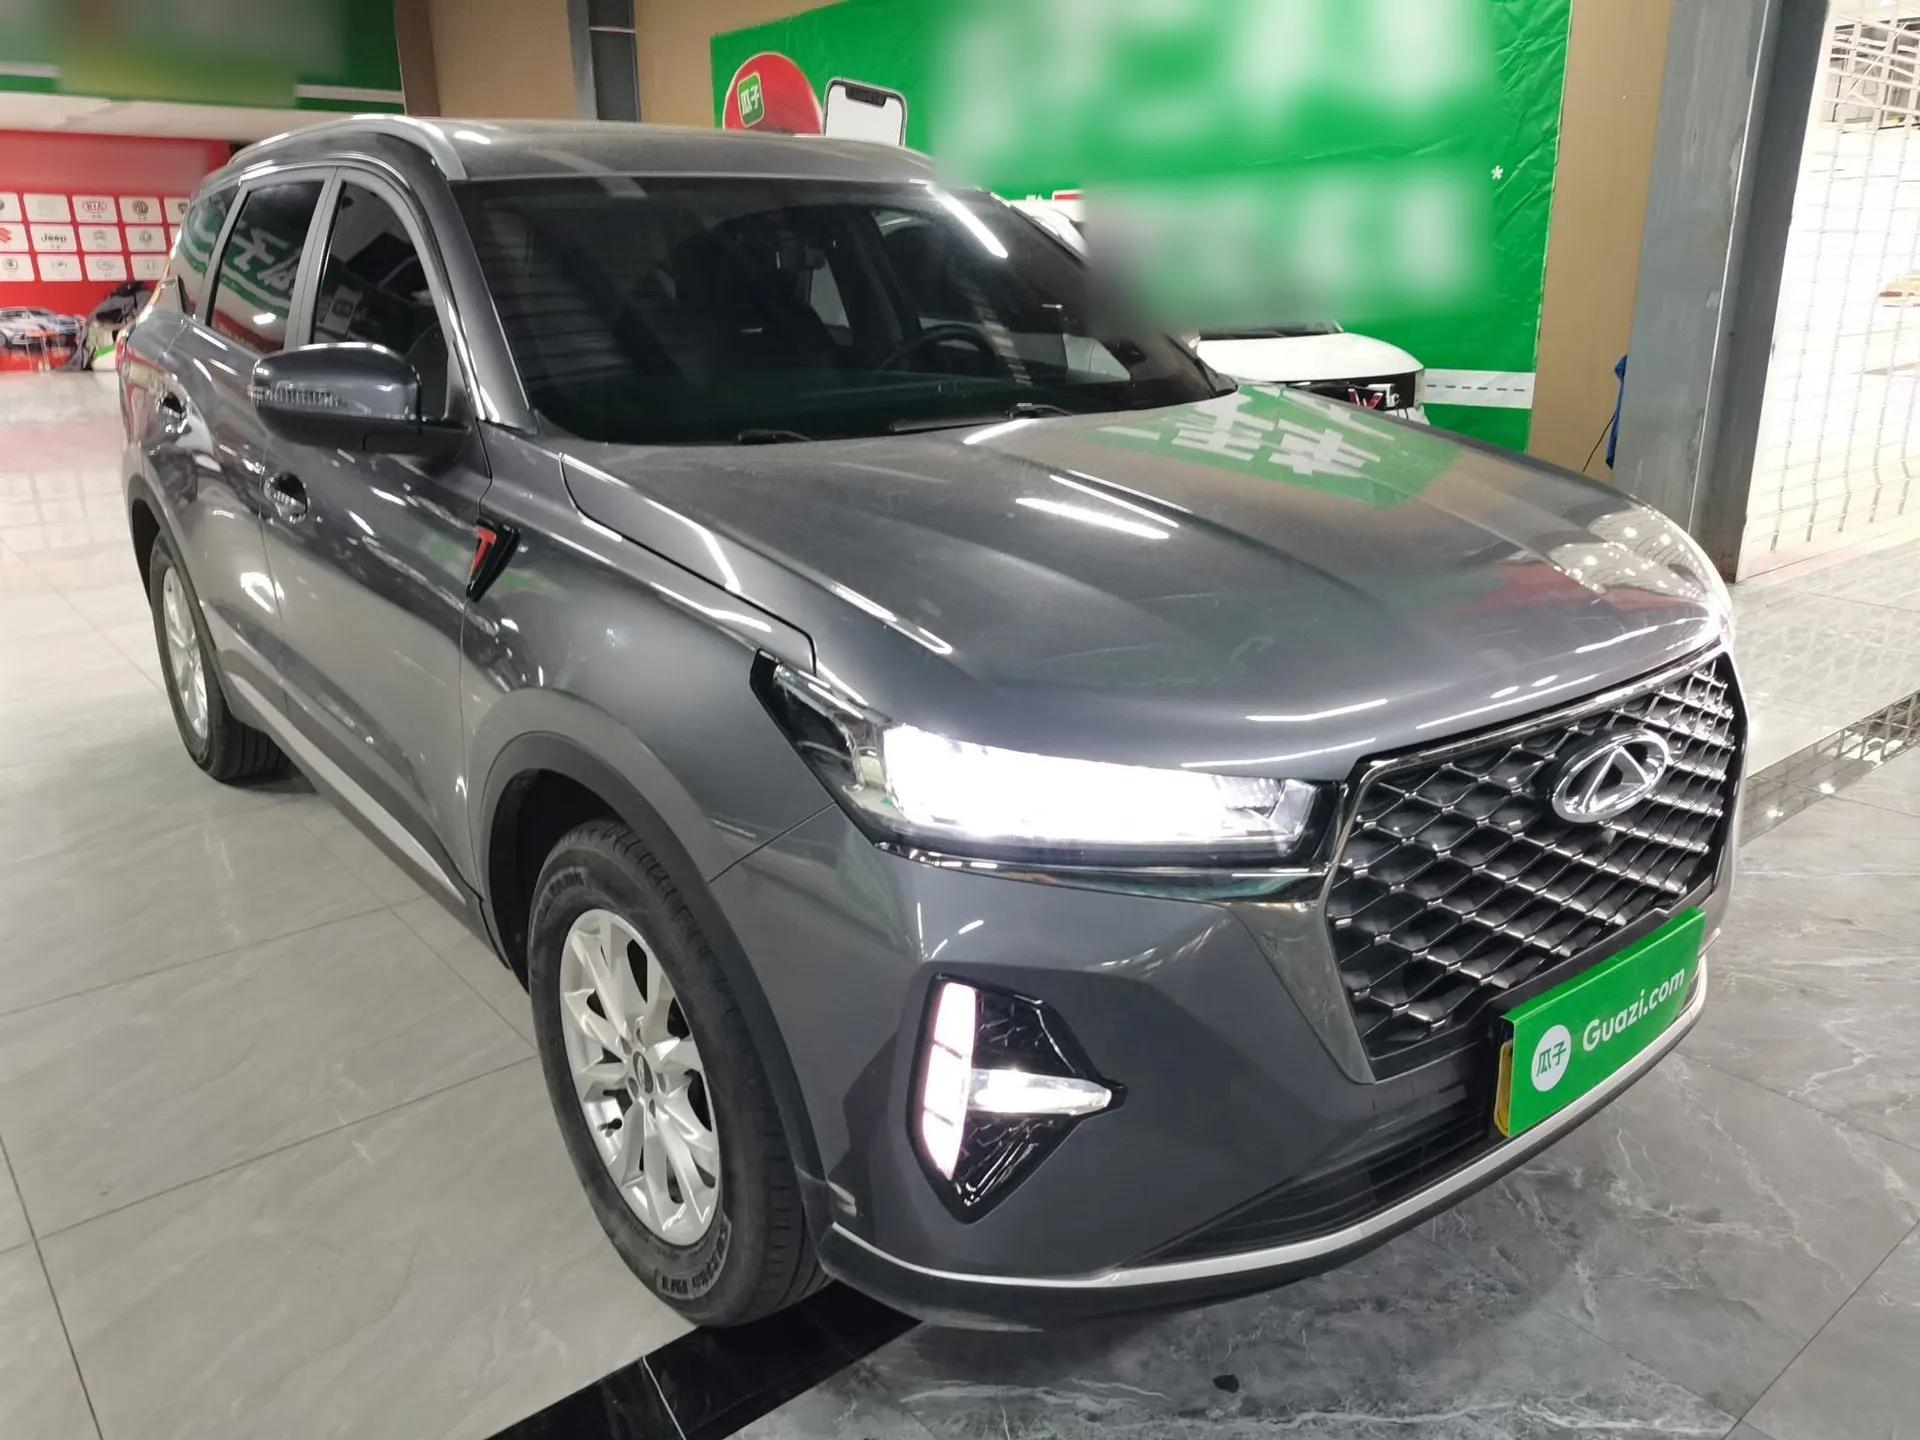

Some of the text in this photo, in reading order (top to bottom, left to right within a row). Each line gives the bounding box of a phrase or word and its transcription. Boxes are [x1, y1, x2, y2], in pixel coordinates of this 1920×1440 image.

[740, 86, 759, 114] 瓜子
[41, 233, 67, 243] Jeep
[1582, 968, 1685, 1052] Guazi.com
[1536, 1041, 1567, 1077] 瓜子
